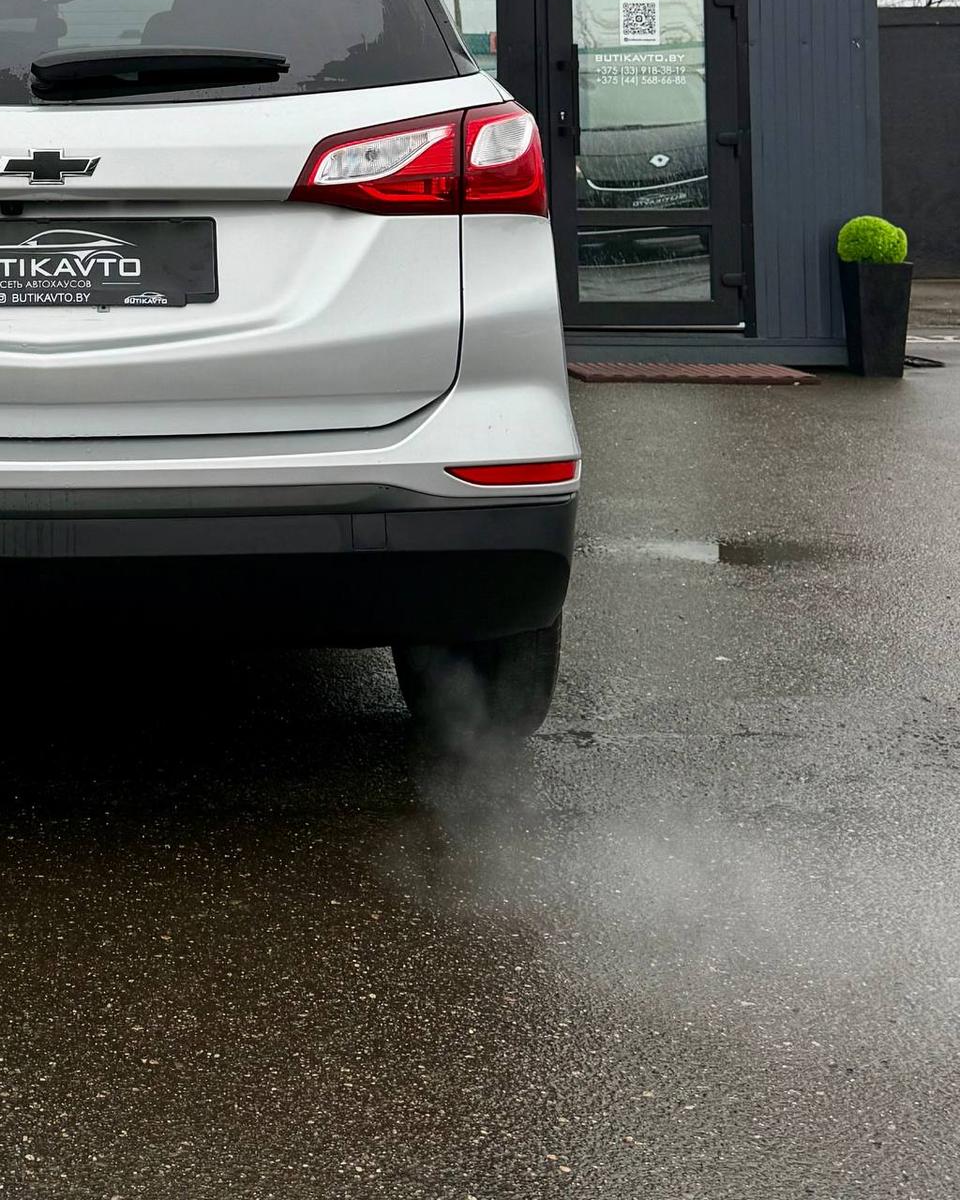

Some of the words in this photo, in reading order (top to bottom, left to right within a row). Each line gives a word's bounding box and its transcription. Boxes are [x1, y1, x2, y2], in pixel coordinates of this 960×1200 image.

[595, 54, 685, 62] BUTIKAVTO.BY
[596, 66, 618, 75] +375
[621, 65, 638, 76] (33)
[641, 66, 687, 75] 918-38-19
[596, 76, 618, 85] +375
[621, 75, 639, 87] (44)
[641, 76, 687, 85] 568-66-88
[0, 280, 23, 289] СЕТЬ
[25, 279, 92, 289] АВТОХАУСОВ
[11, 292, 91, 303] BUTIKAVTO.BY
